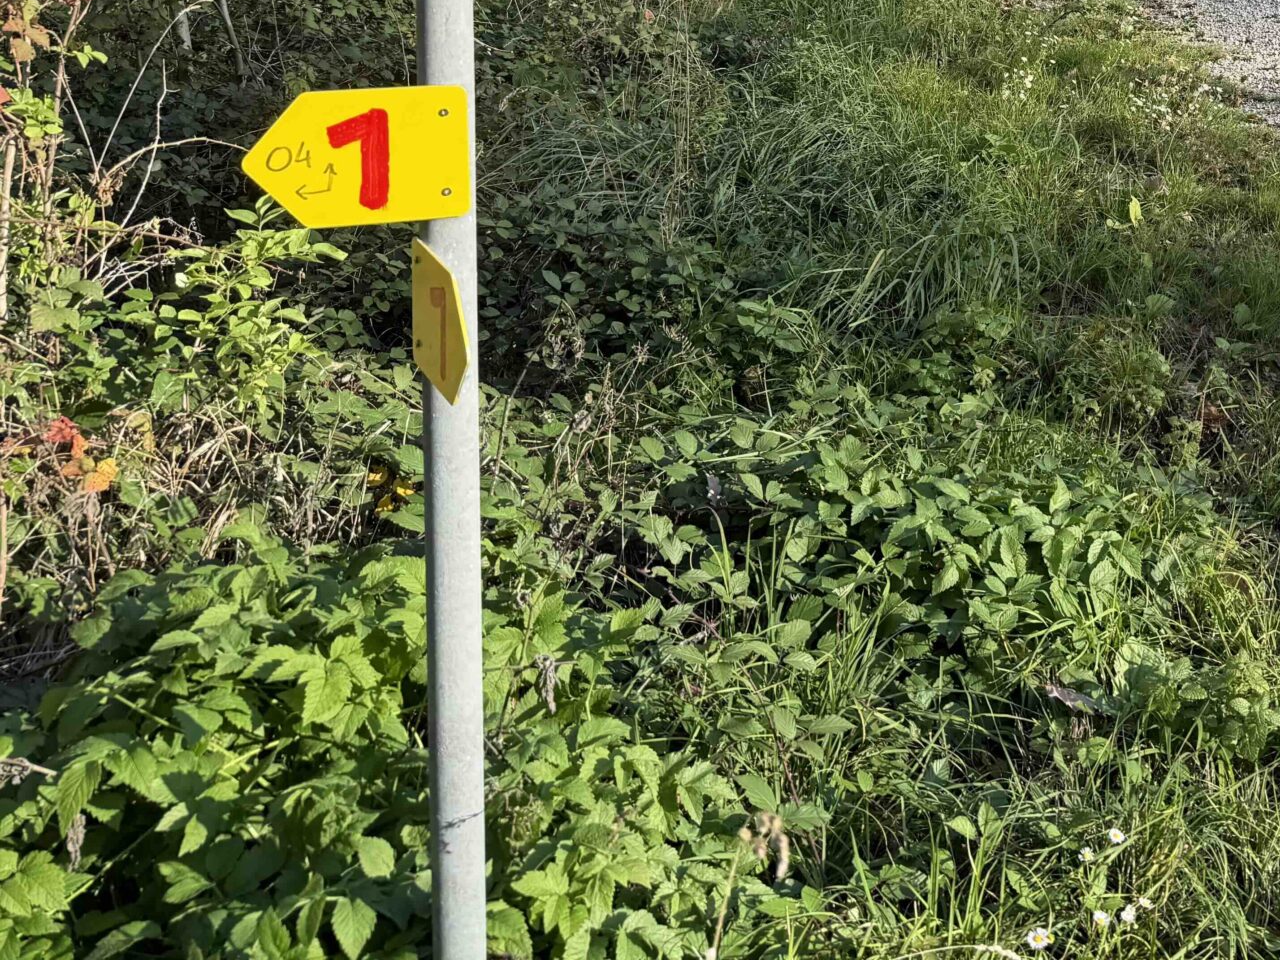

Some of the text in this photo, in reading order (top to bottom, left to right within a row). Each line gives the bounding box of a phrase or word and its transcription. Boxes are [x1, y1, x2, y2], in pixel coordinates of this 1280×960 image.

[265, 141, 312, 172] 04
[326, 108, 390, 210] 1
[429, 286, 447, 382] 1
